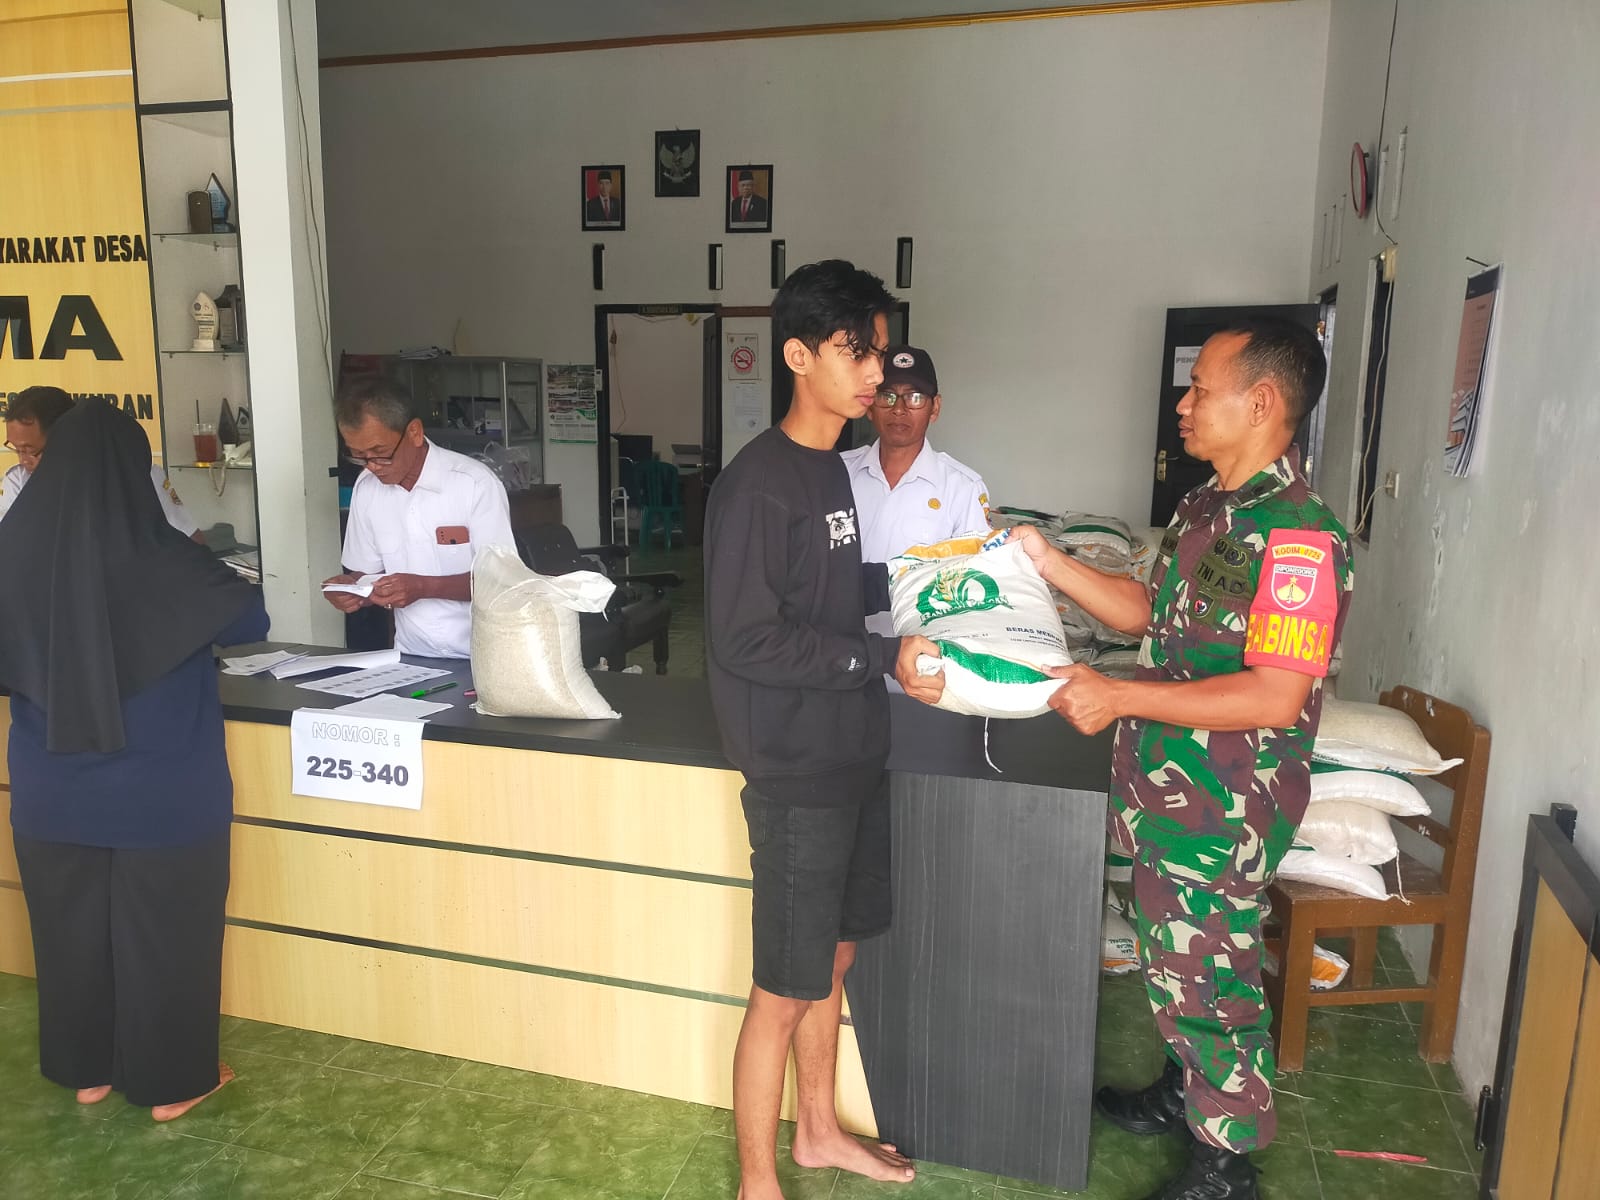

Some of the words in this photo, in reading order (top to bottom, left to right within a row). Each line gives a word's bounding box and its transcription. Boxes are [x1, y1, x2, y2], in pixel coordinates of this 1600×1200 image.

[93, 234, 148, 263] DESA
[1197, 561, 1215, 583] TNI
[1214, 575, 1246, 595] AD
[311, 721, 389, 747] NOMOR
[306, 755, 410, 787] 225-340
